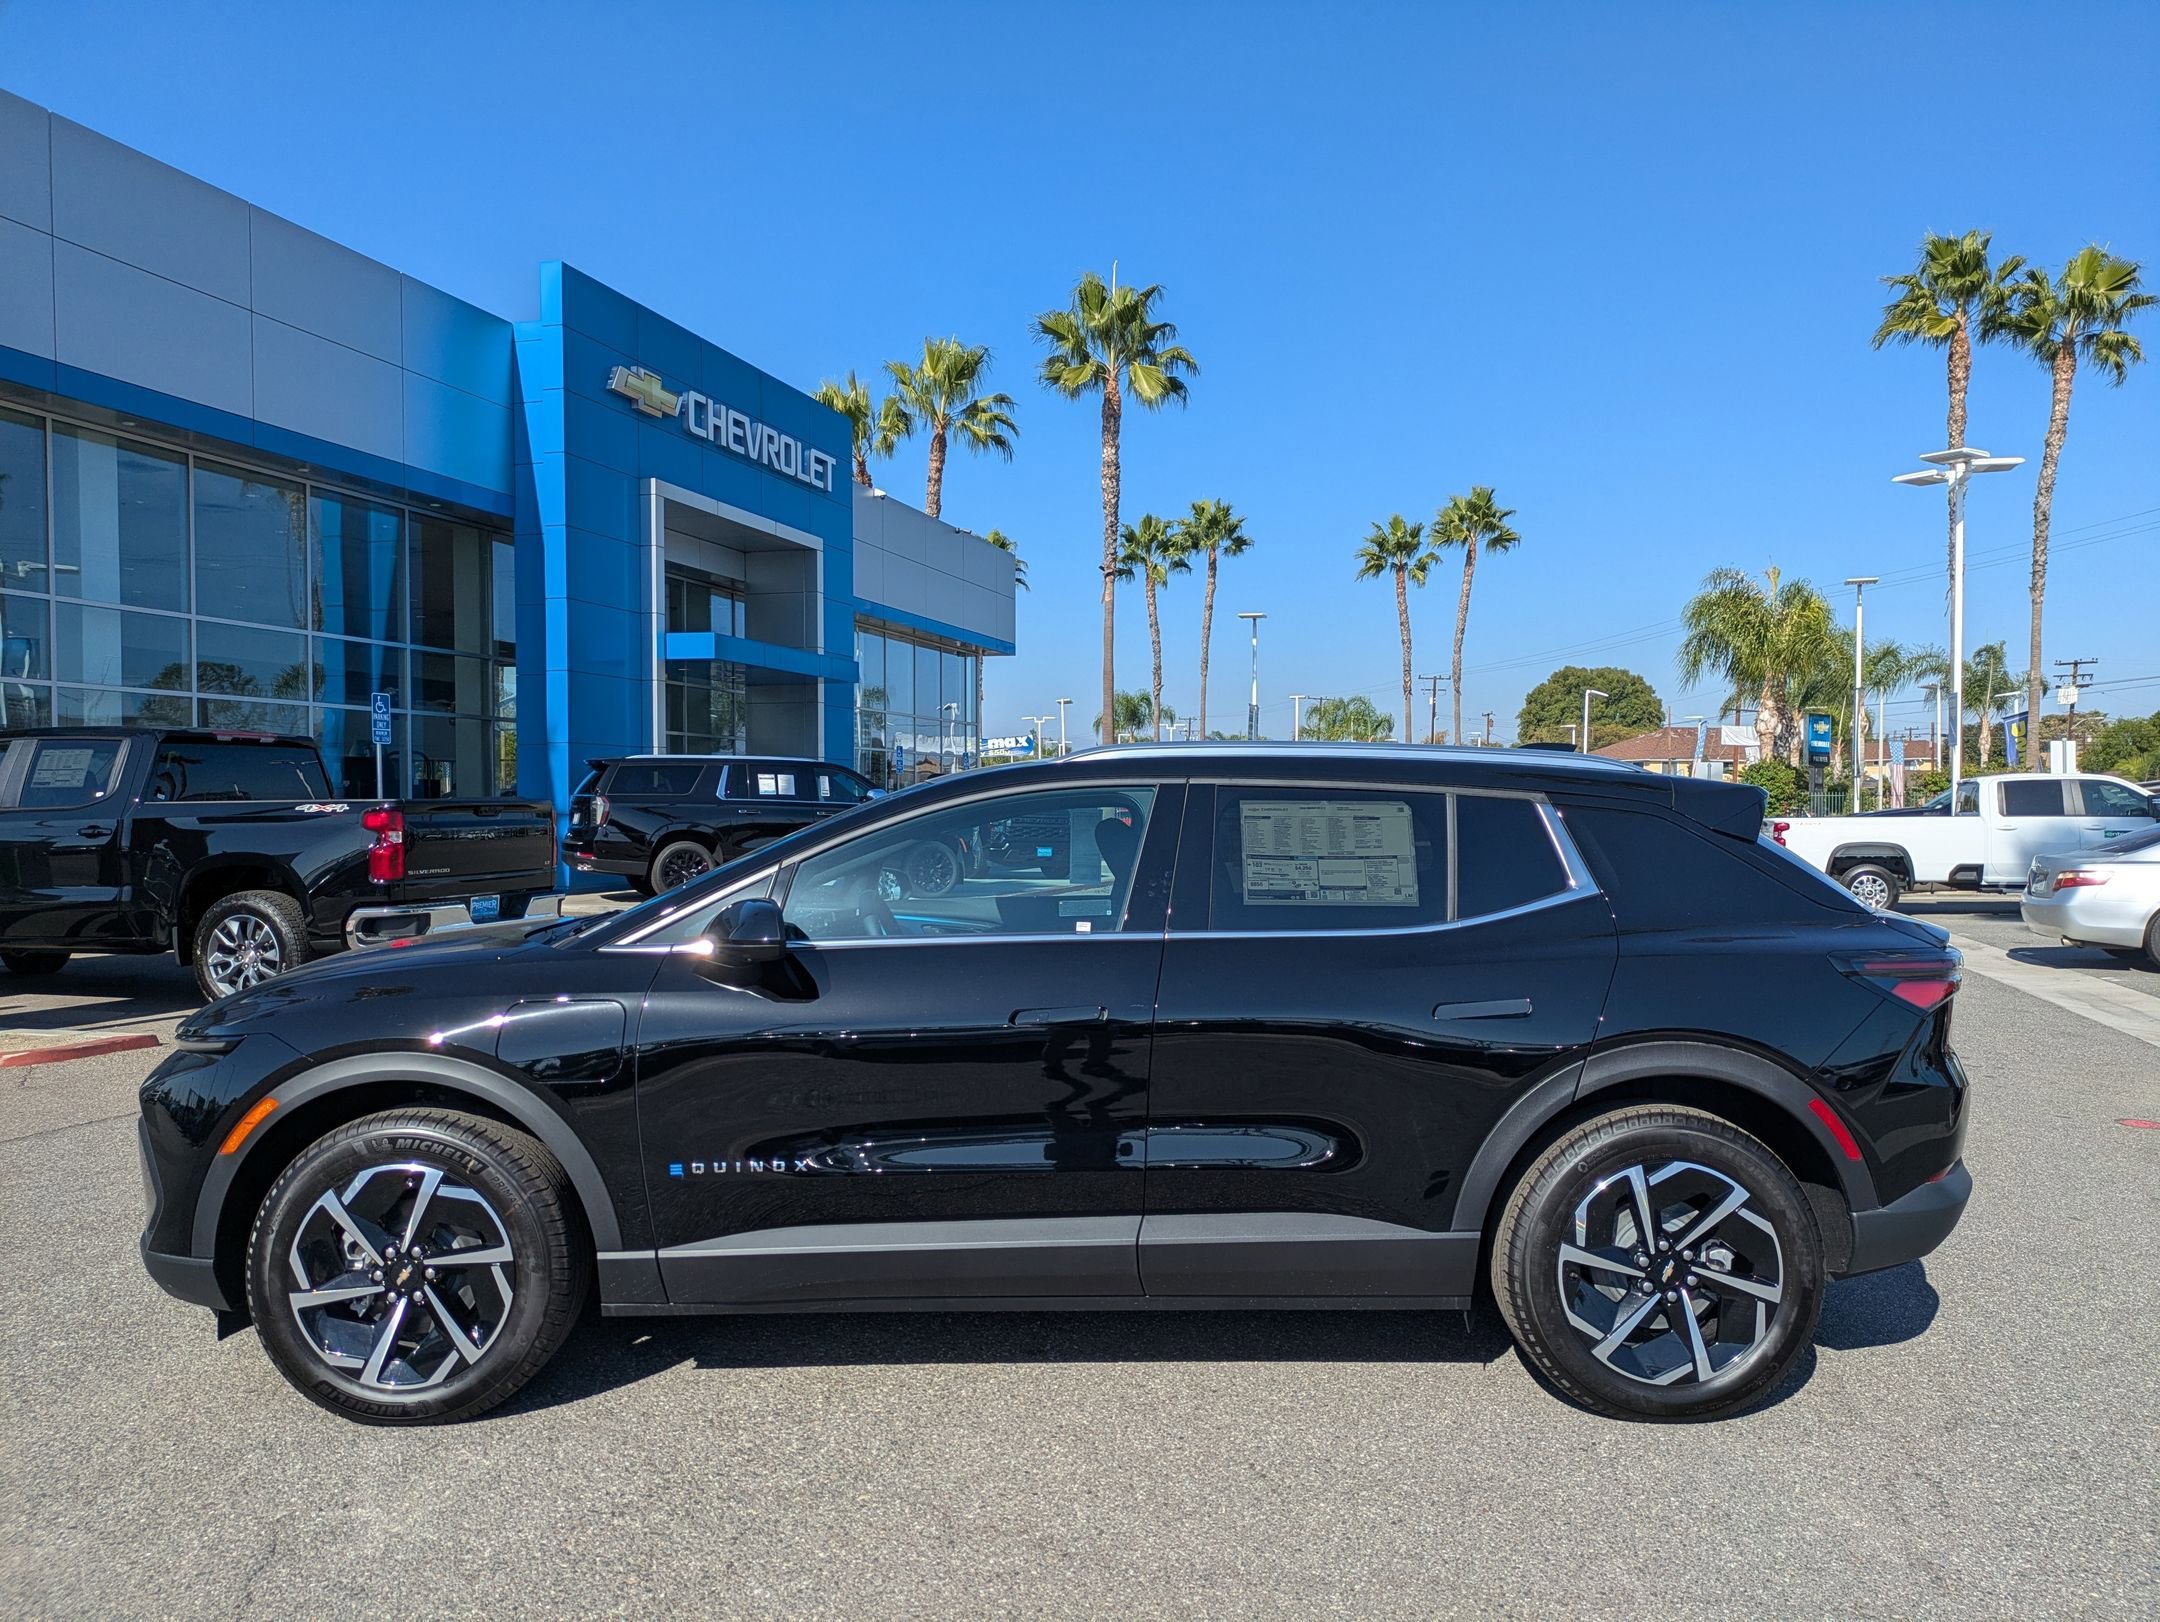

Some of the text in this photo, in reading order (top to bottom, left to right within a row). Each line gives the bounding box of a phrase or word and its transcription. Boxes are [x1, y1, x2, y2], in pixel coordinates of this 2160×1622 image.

[684, 390, 836, 492] CHEVROLET
[472, 900, 497, 910] PREMIER
[395, 1138, 485, 1175] MICHELIN
